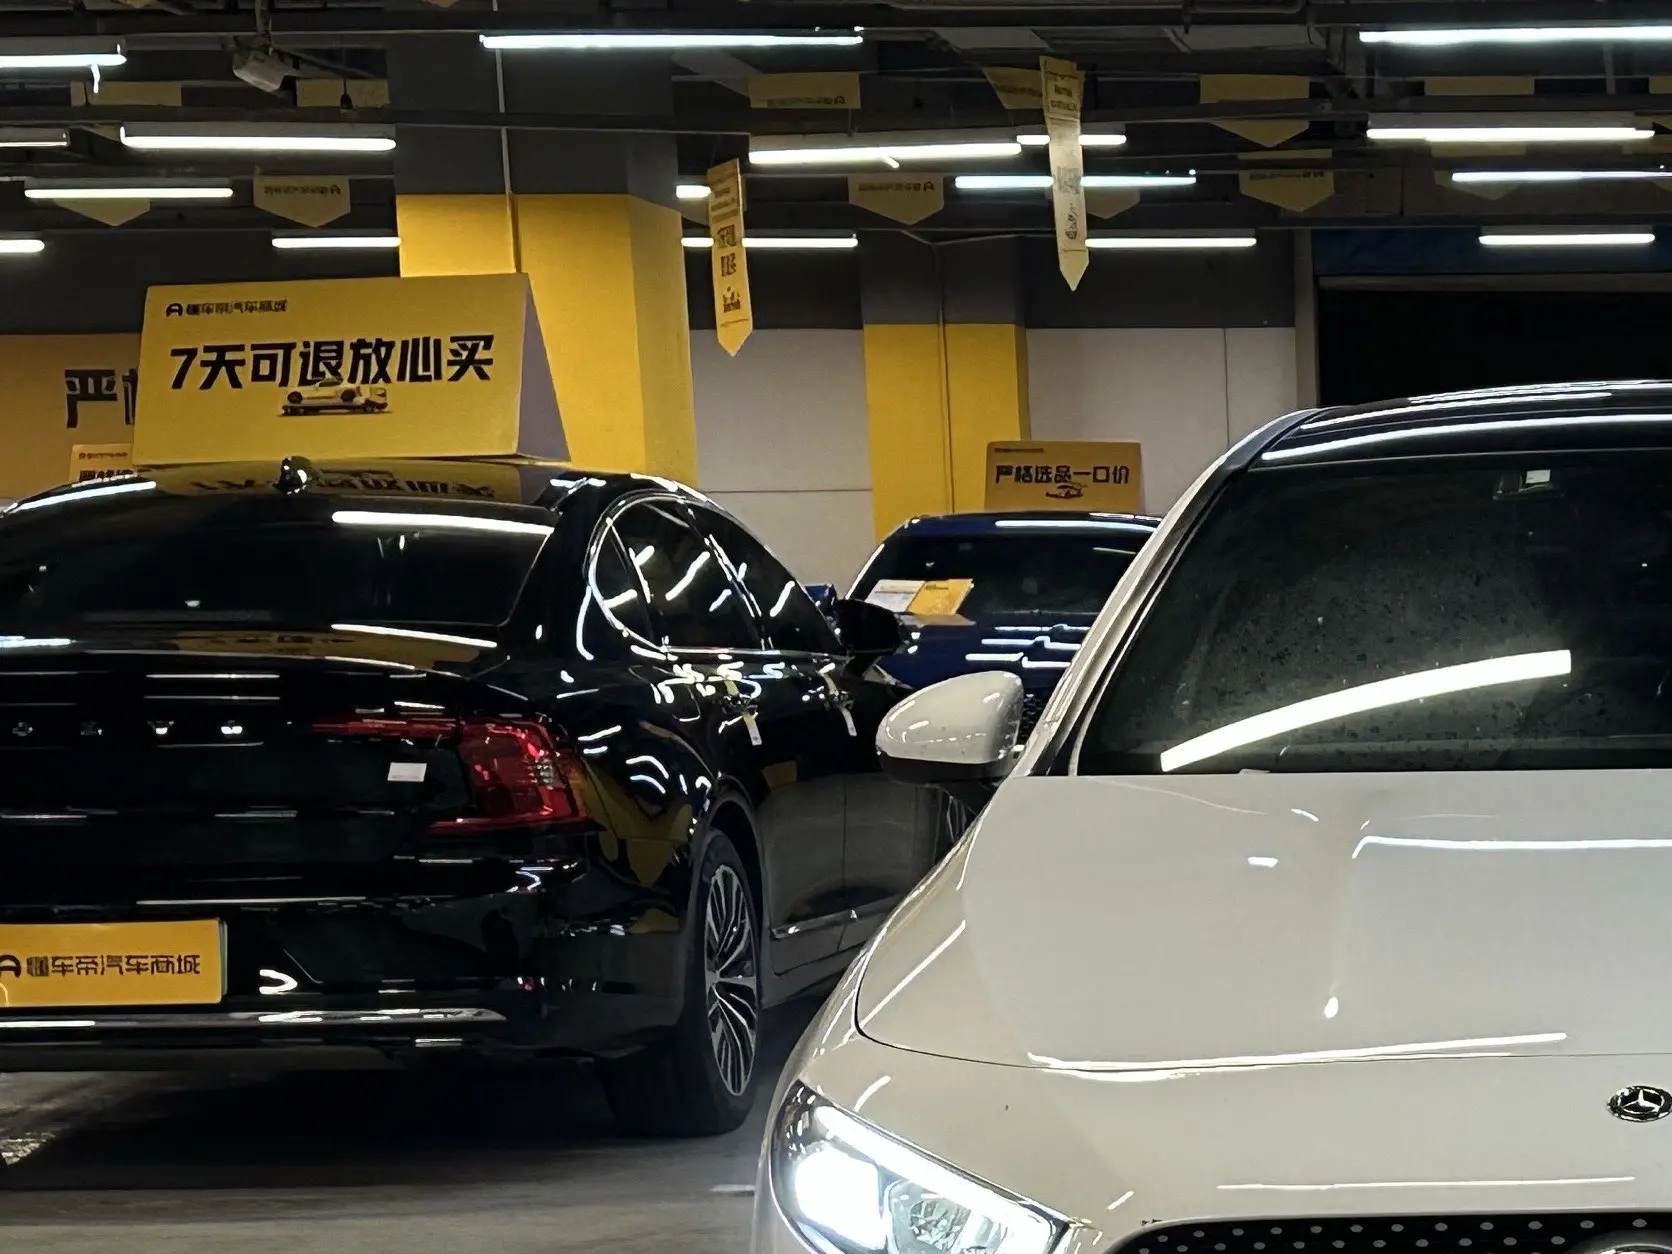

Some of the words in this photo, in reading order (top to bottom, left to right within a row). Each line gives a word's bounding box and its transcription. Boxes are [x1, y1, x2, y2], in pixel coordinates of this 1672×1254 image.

[170, 334, 495, 390] 7天可退放心买
